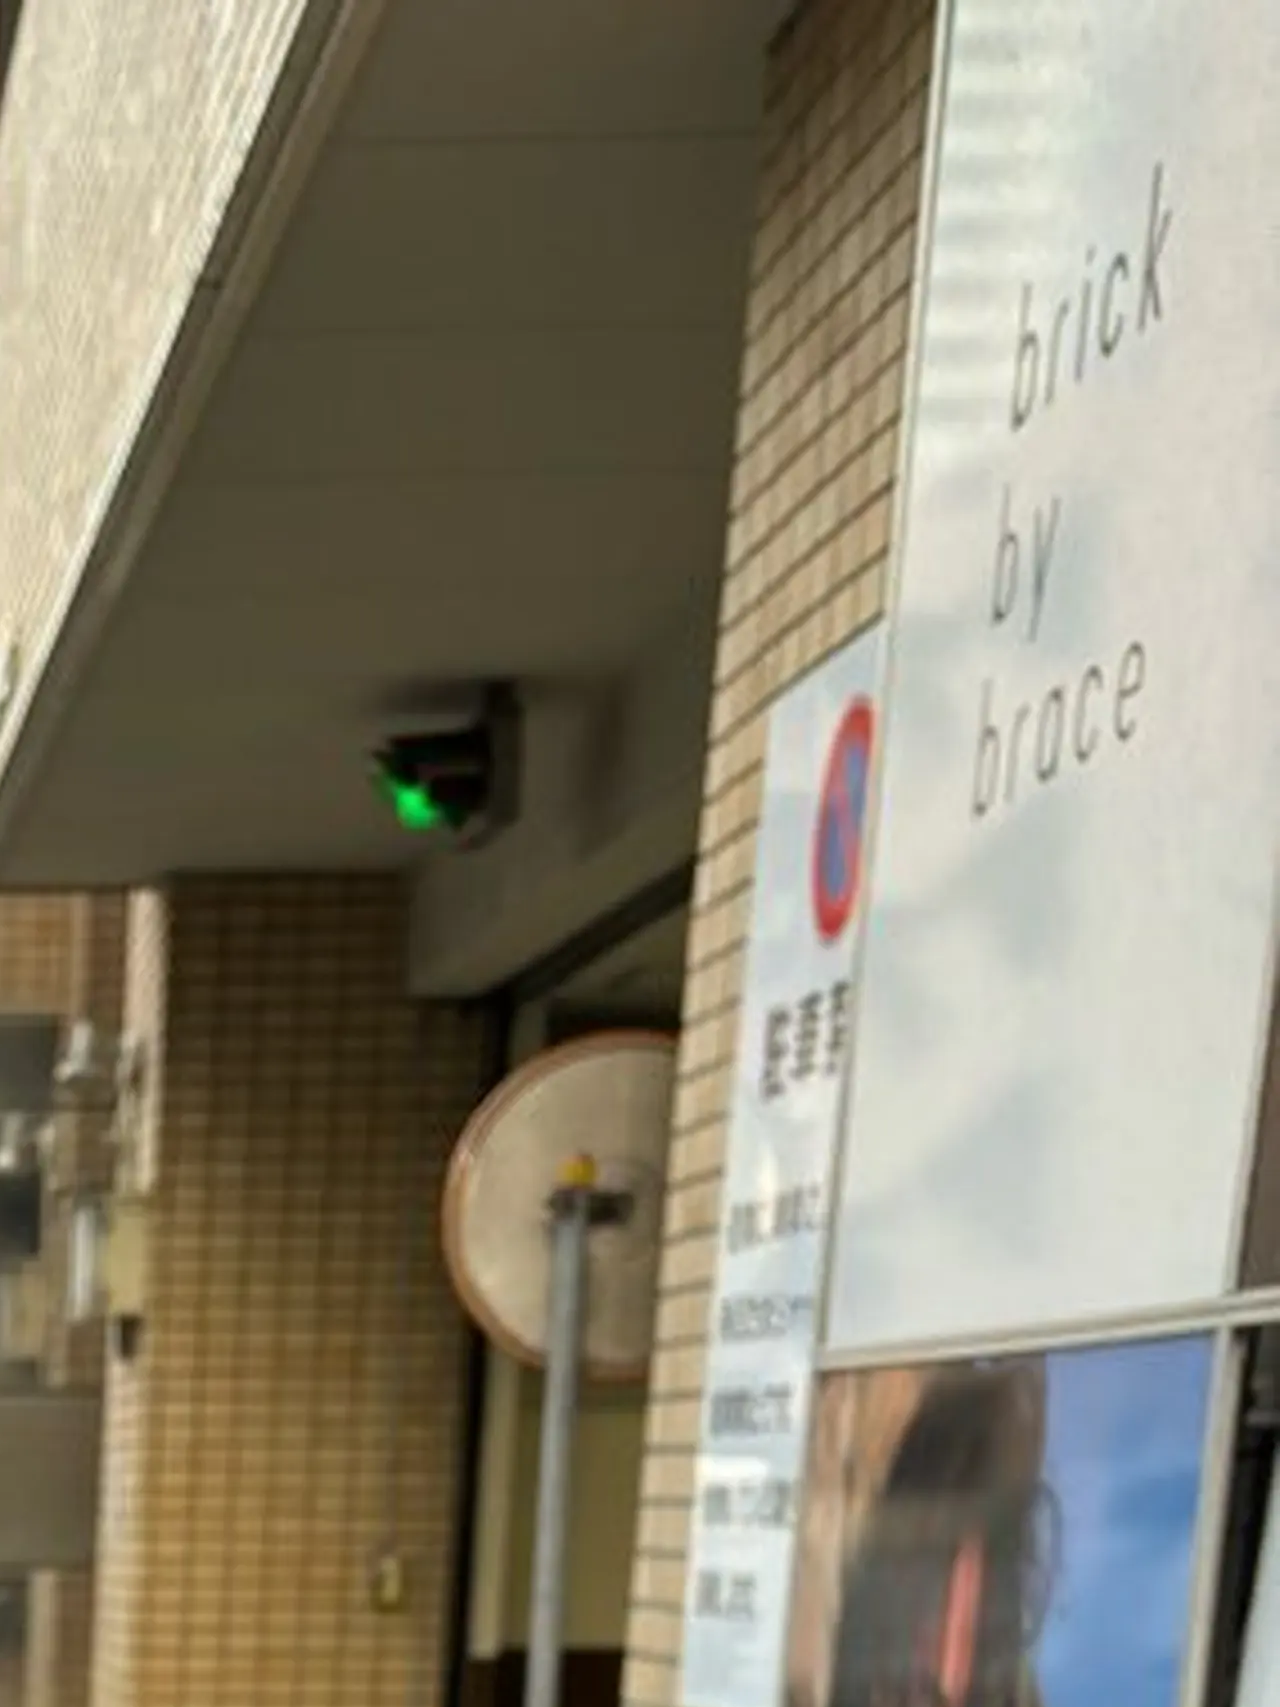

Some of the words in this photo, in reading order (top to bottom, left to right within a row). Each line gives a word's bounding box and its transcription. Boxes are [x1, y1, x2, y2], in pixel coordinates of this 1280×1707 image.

[1010, 163, 1175, 431] brick
[991, 485, 1062, 642] by
[970, 640, 1148, 820] brace
